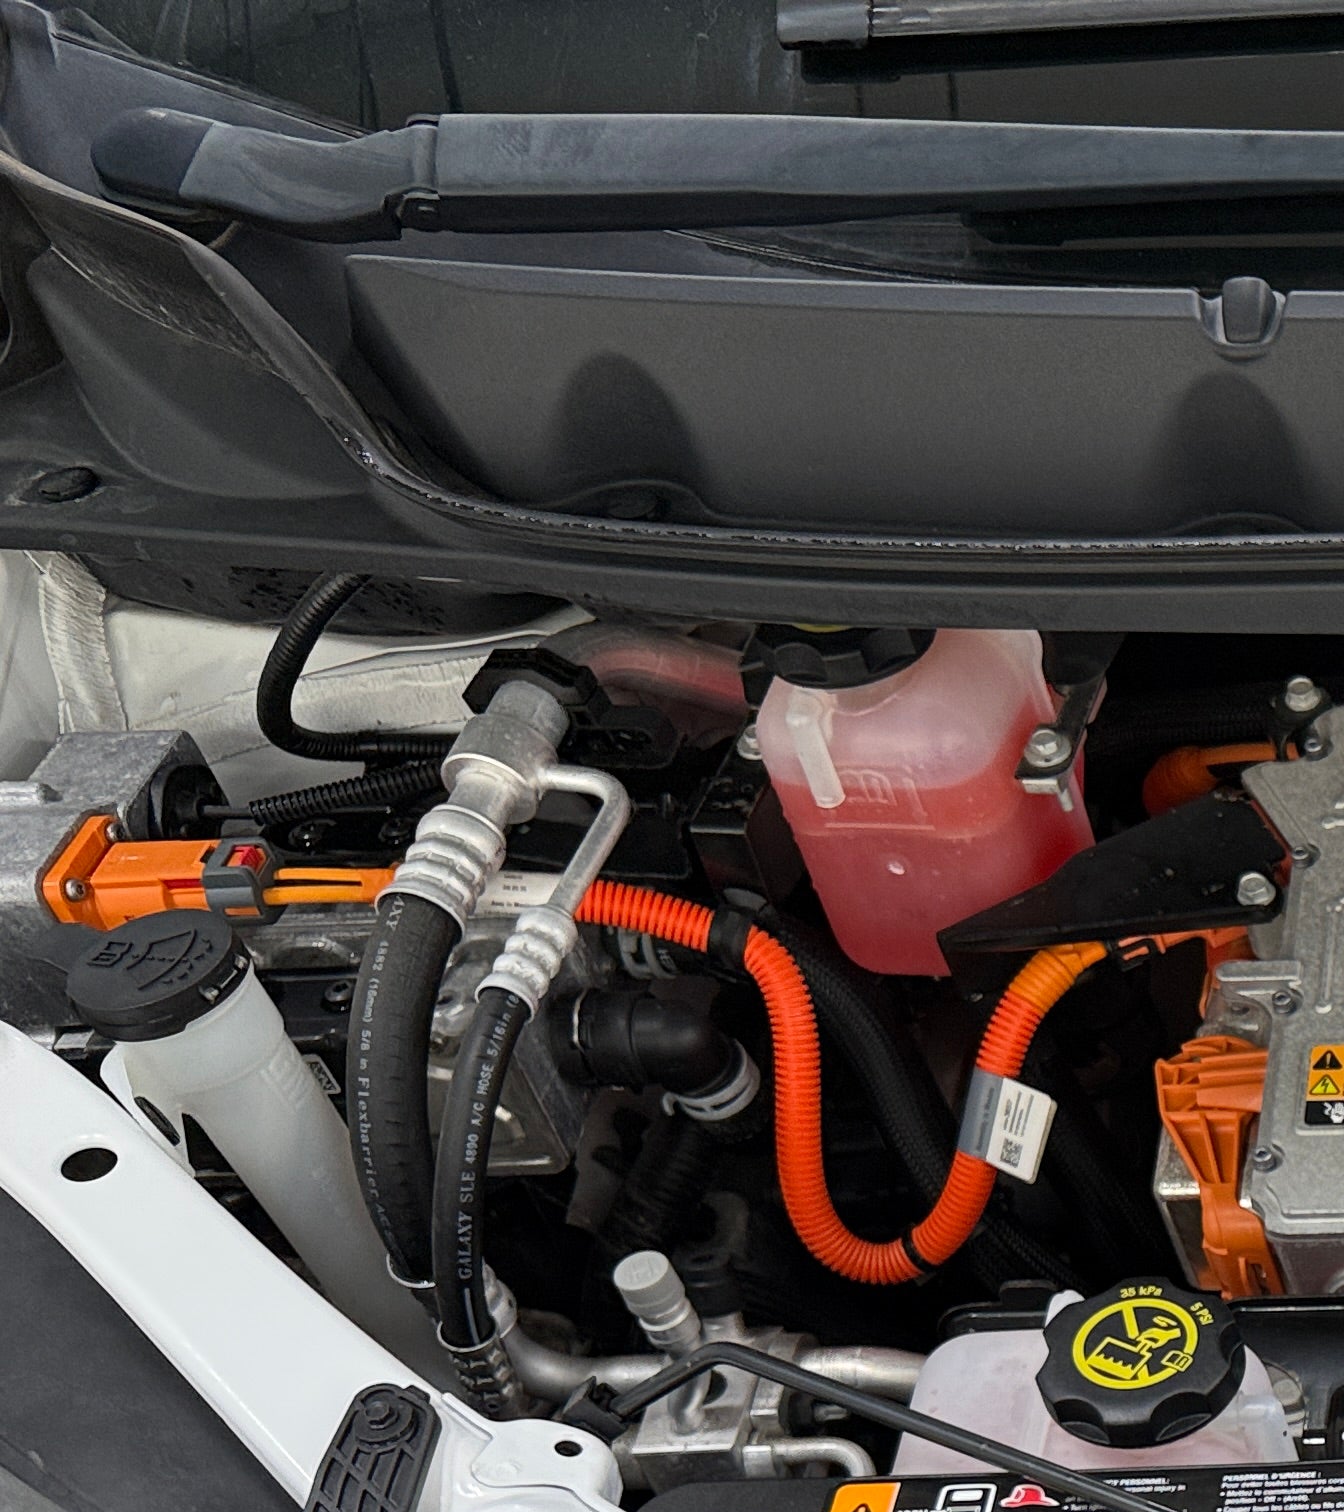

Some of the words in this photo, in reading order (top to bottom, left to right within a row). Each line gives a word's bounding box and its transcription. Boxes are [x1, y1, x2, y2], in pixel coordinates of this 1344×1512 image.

[360, 1030, 373, 1050] 5/8
[476, 1064, 495, 1095] HOSE
[471, 1102, 486, 1127] A/C
[357, 1077, 379, 1199] Flexbarrier
[465, 1132, 480, 1164] 4890
[459, 1170, 476, 1203] SLE
[457, 1210, 474, 1280] GALAXY
[1119, 1287, 1137, 1299] 35
[1139, 1285, 1163, 1297] kPa
[1190, 1301, 1203, 1312] 5
[1196, 1309, 1214, 1326] PSI
[1222, 1473, 1269, 1482] PERSONNEL
[1271, 1471, 1317, 1480] D'URGENCE
